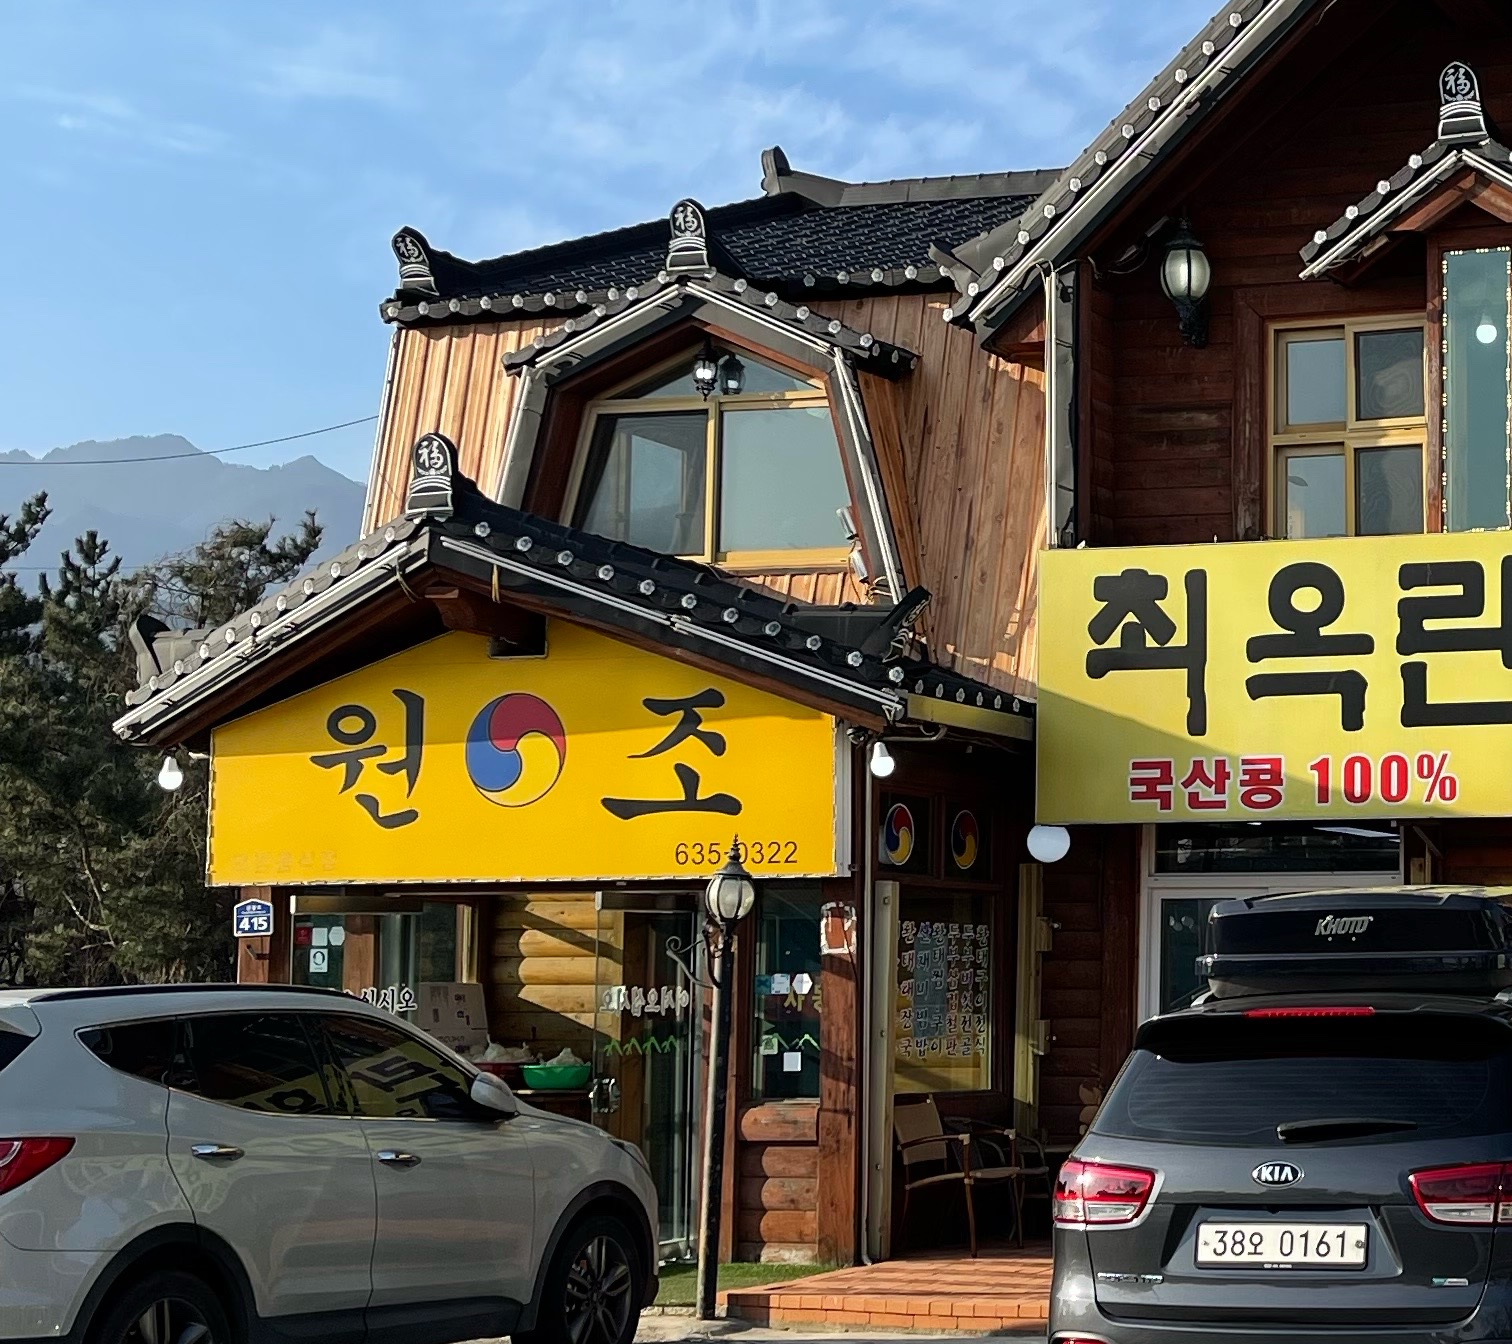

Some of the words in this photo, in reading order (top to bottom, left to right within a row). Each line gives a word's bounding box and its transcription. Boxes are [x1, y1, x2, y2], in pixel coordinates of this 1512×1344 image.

[1445, 68, 1470, 94] 福
[674, 207, 698, 232] 福
[417, 440, 443, 470] 福
[309, 688, 426, 830] 원
[600, 687, 743, 819] 조
[1129, 756, 1285, 812] 국산콩
[1311, 752, 1458, 805] 100%
[239, 916, 268, 931] 415
[1261, 1165, 1294, 1182] KIA
[1212, 1229, 1264, 1258] 38오
[1279, 1229, 1347, 1258] 0161
